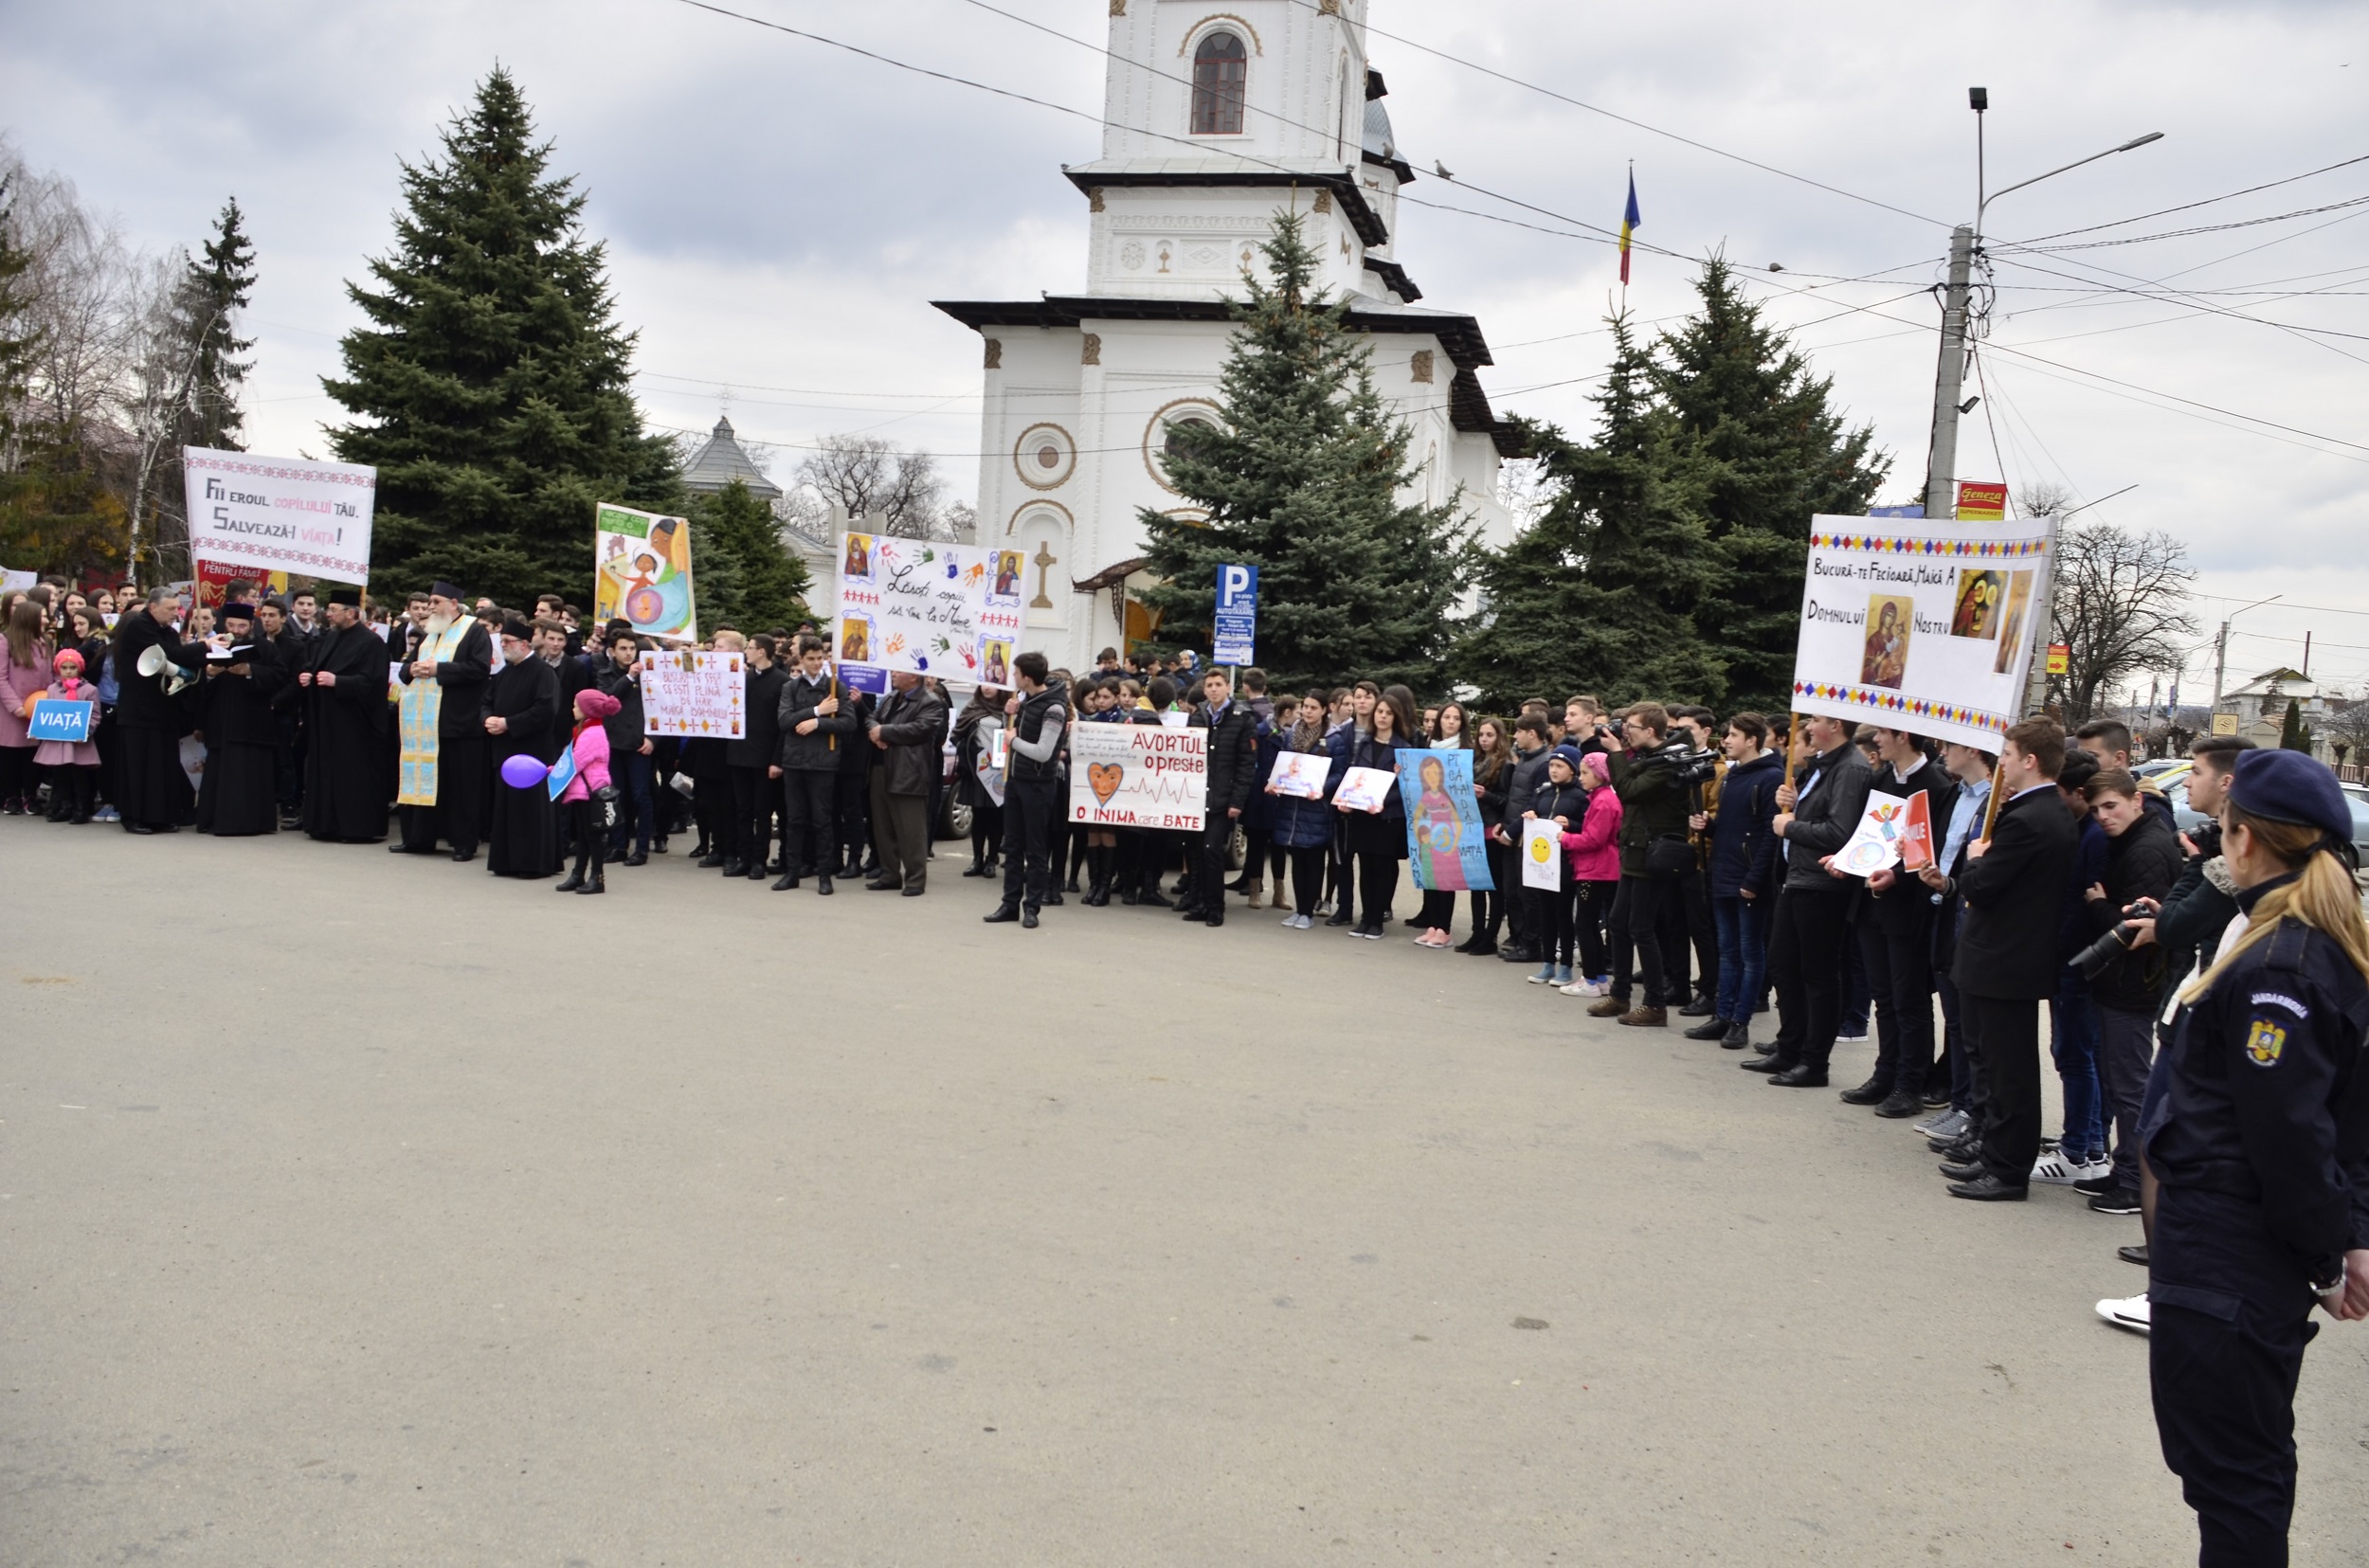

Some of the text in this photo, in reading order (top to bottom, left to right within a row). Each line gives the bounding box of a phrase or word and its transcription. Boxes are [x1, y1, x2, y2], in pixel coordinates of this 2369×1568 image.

[206, 478, 360, 518] Fii EROUL COPILULUI TĂU.
[1961, 488, 2002, 502] Geneza
[1960, 508, 2001, 517] SUPERMARKET
[204, 564, 237, 577] PENTRU
[1814, 557, 1867, 580] BUCURĂ-TE
[1945, 566, 1955, 586] A
[1224, 566, 1249, 606] P
[1216, 607, 1255, 616] AUTOTAXARE
[1807, 599, 1950, 635] DOMNULUI NOSTRU
[40, 711, 82, 730] VIAȚĂ
[1131, 732, 1205, 754] AVORTUL
[1076, 805, 1086, 819] O
[1138, 815, 1159, 825] care
[1164, 814, 1200, 828] BATE
[2251, 993, 2308, 1019] JANDARMERIA
